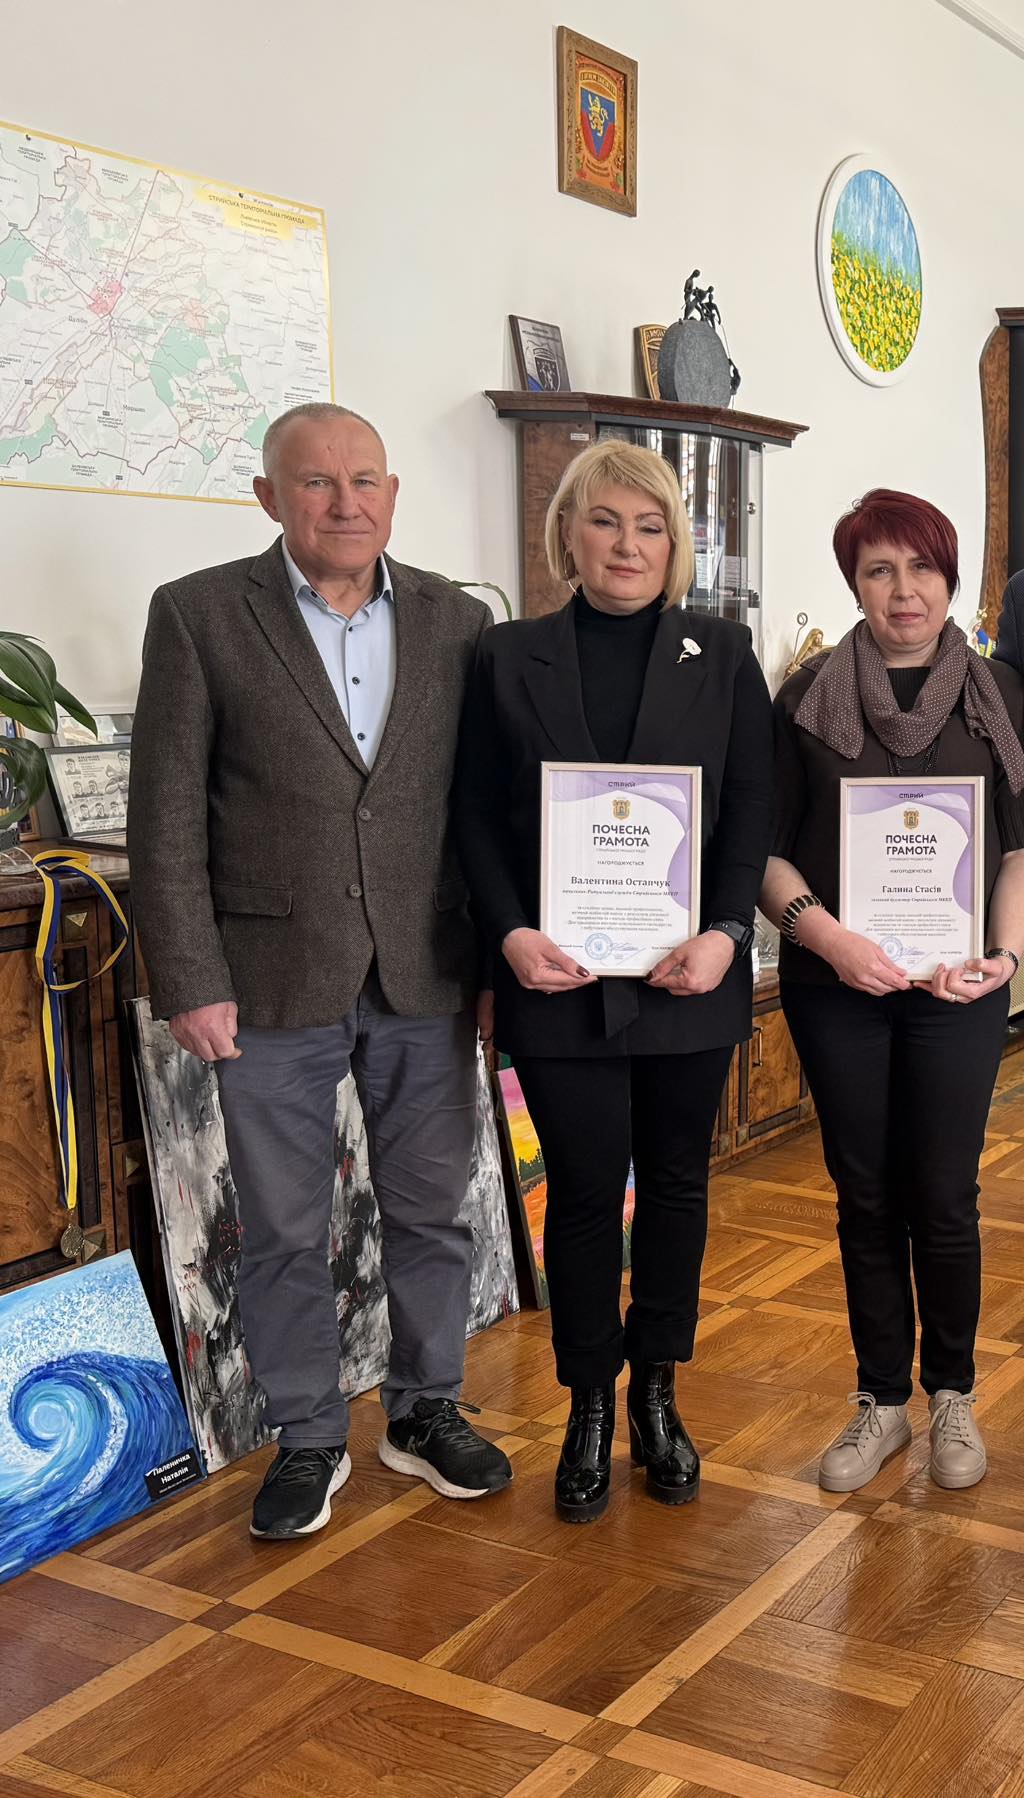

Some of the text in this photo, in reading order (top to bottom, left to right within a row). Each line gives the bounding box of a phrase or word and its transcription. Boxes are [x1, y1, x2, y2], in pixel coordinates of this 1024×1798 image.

[592, 824, 650, 835] ПОЧЕСНА
[593, 836, 650, 847] ГРАМОТА
[885, 835, 938, 844] ПОЧЕСНА
[886, 846, 937, 855] ГРАМОТА
[570, 876, 671, 888] Валентина Остапчук
[149, 1453, 191, 1477] Паленичка
[160, 1466, 189, 1484] Наталія
